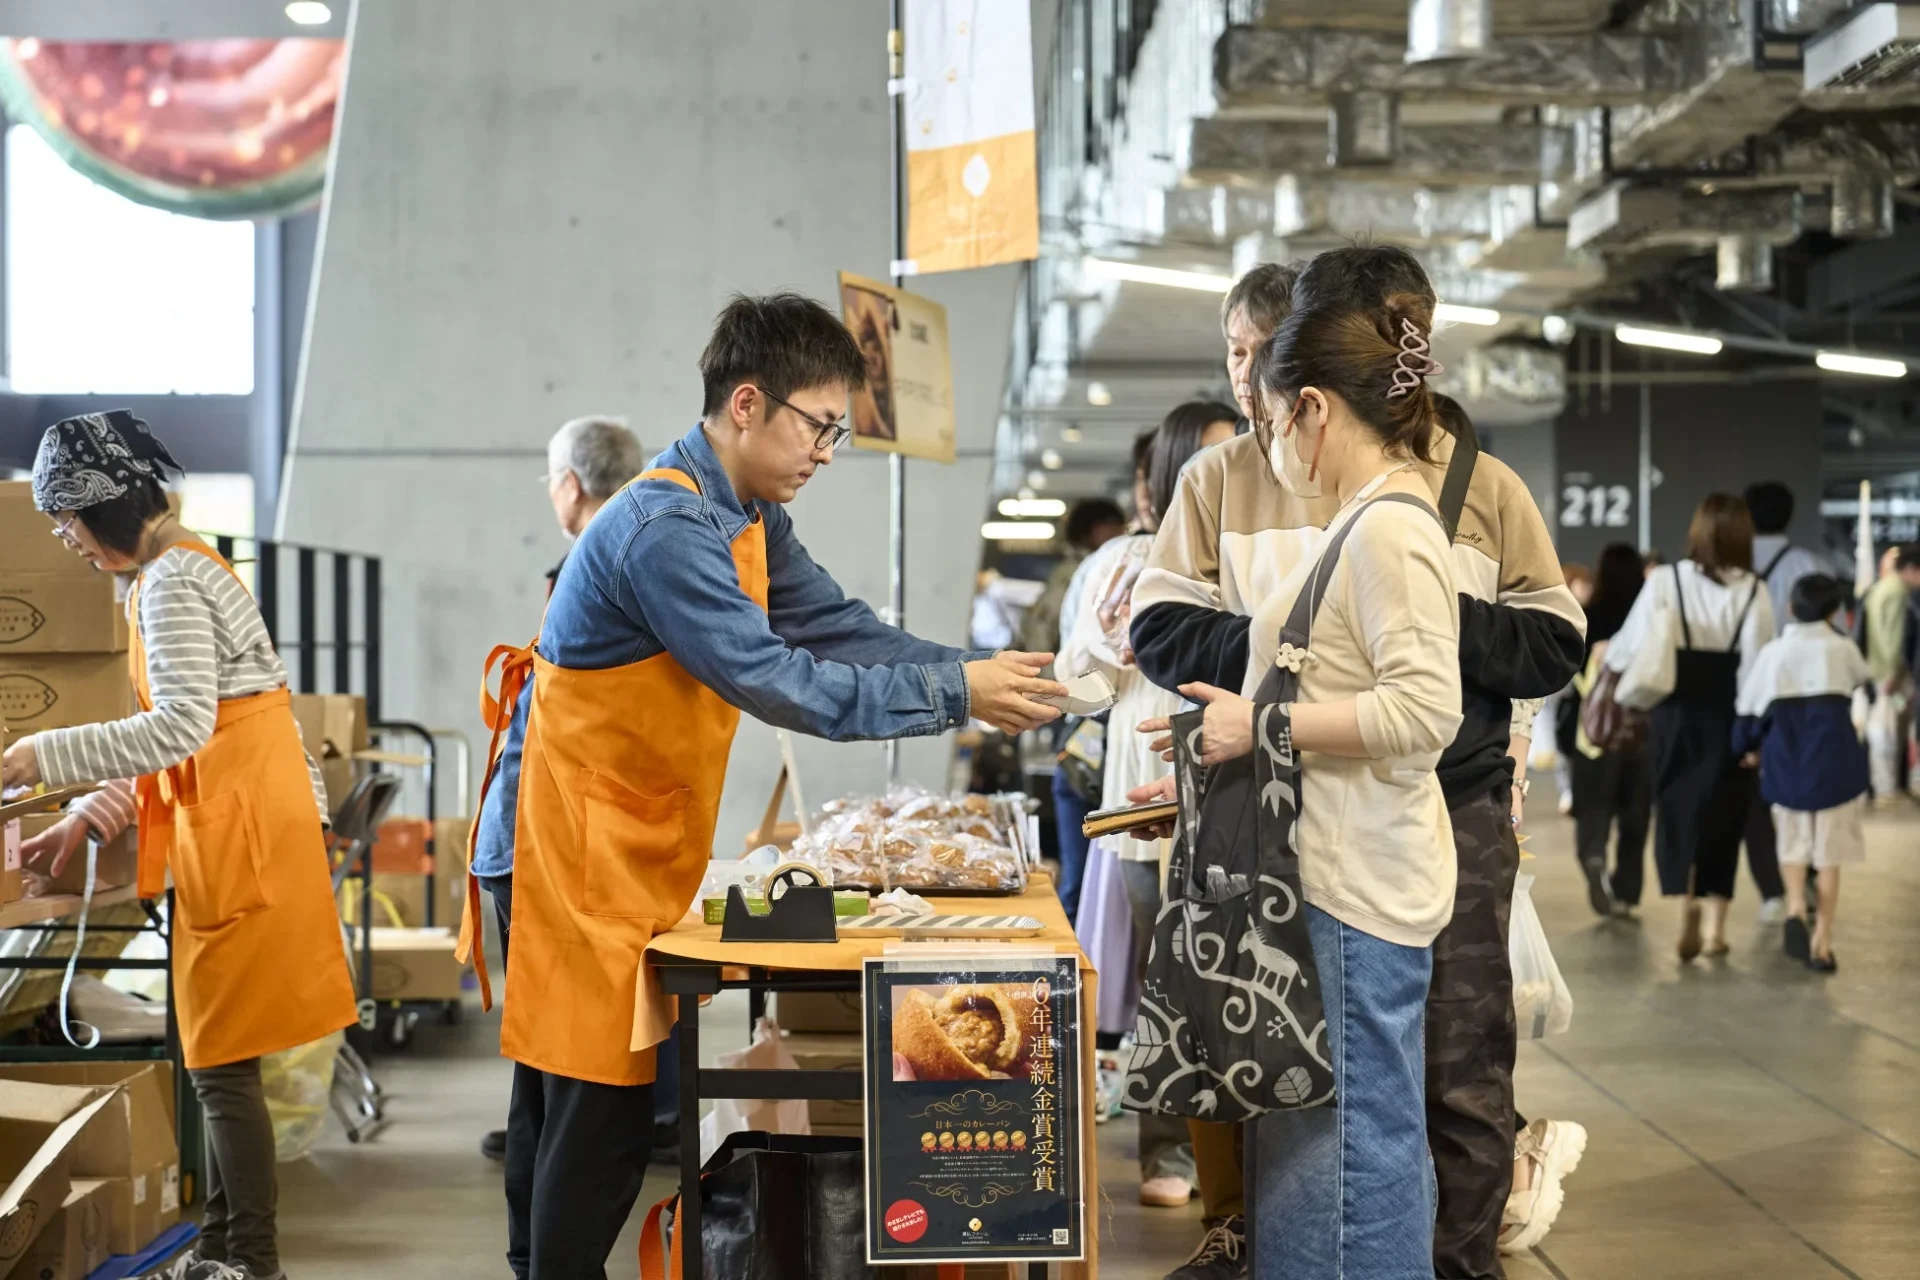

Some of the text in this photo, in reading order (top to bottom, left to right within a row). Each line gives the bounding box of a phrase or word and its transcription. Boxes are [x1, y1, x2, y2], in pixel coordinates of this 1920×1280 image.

[1561, 485, 1631, 527] 212
[1029, 976, 1056, 1192] 6年連続金賞受賞
[935, 1120, 1012, 1130] 日本一のカレーパン
